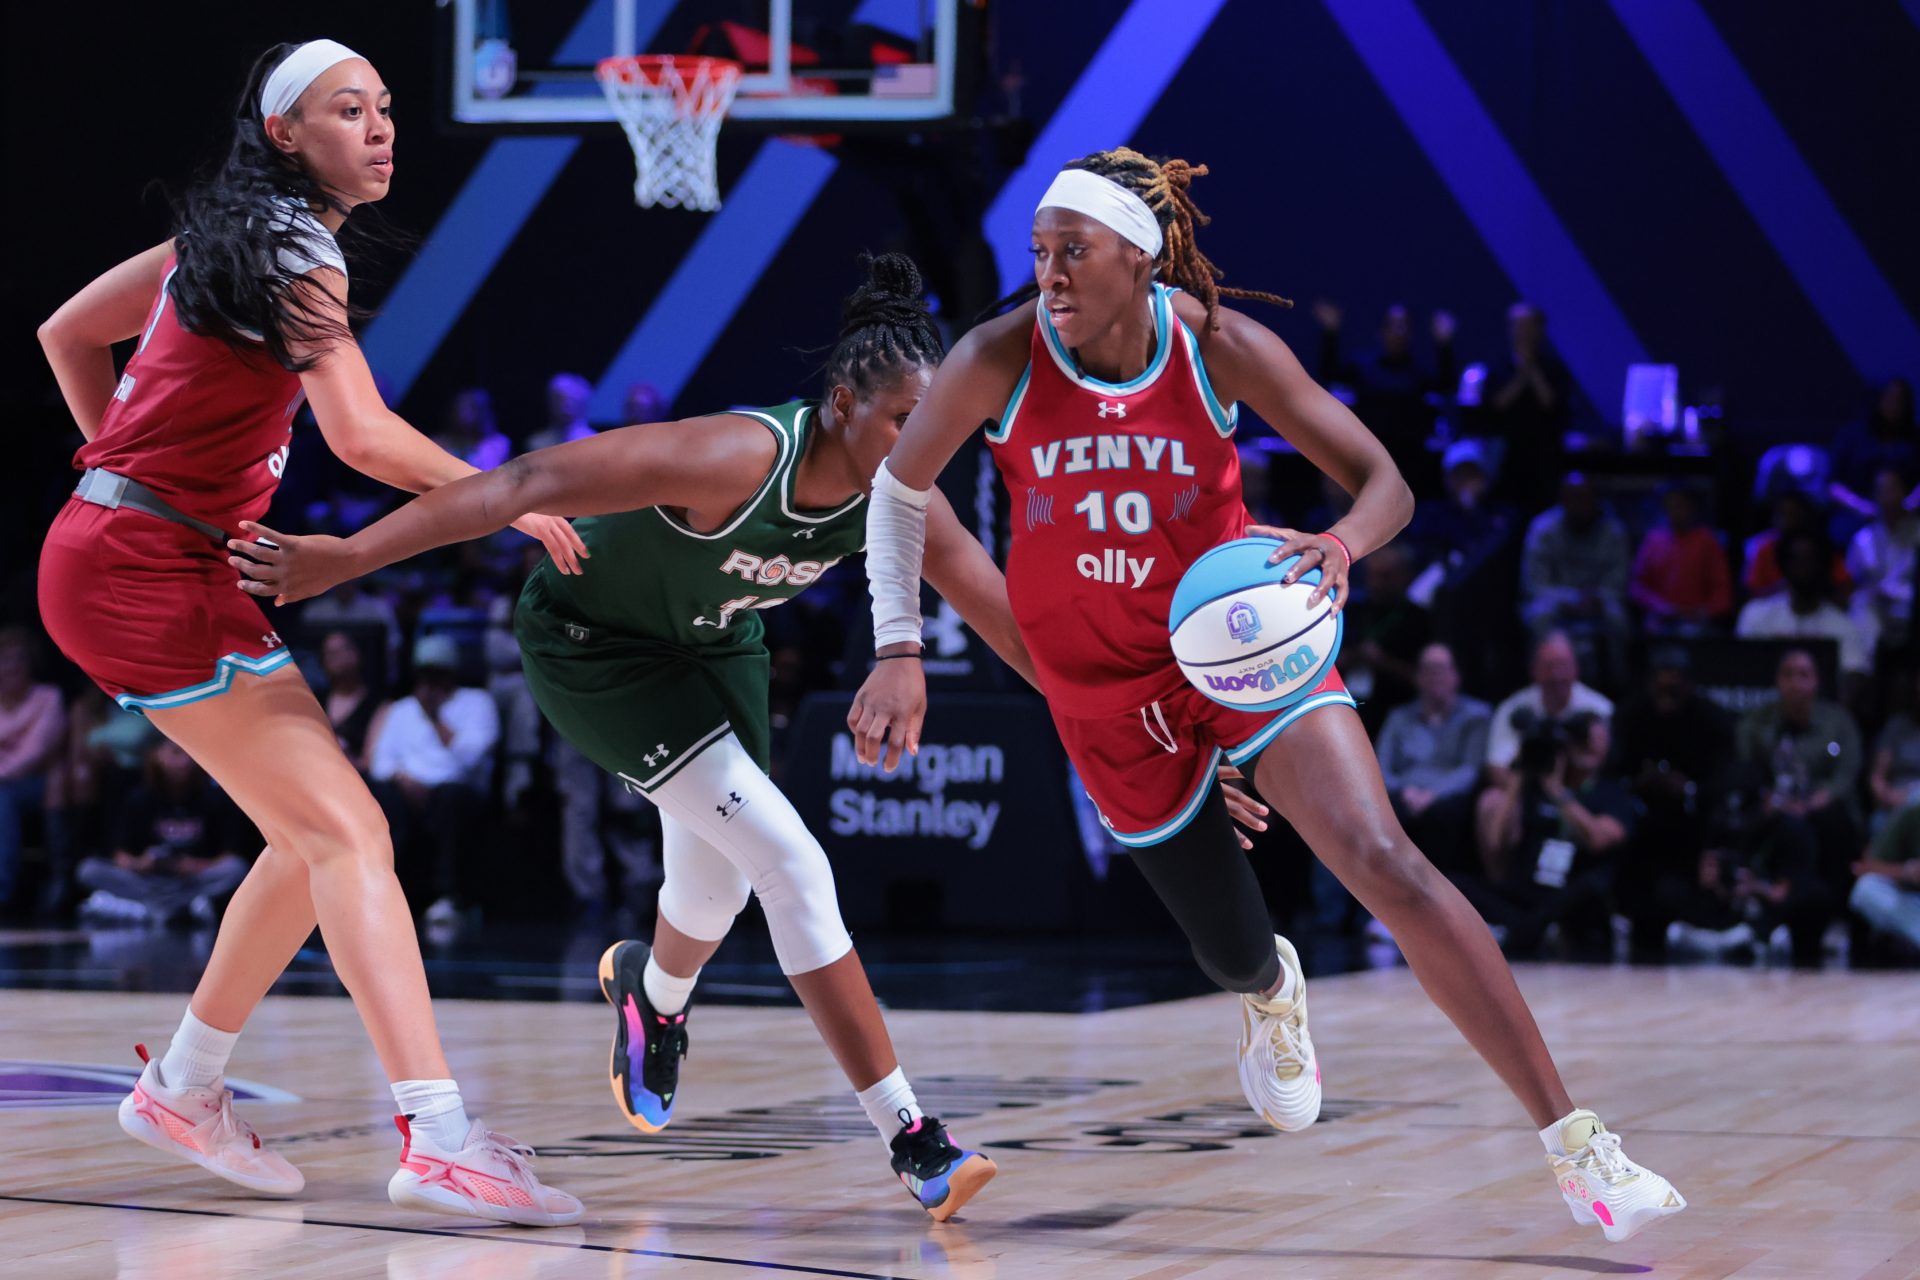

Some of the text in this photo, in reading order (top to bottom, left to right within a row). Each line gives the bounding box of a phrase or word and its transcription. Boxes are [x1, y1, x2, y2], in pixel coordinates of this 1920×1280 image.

[1030, 434, 1196, 479] VINYL
[1074, 490, 1153, 535] 10
[1076, 548, 1156, 589] ally
[1203, 644, 1319, 692] Wilson
[1256, 658, 1274, 669] EVO
[829, 788, 1000, 850] Stanley
